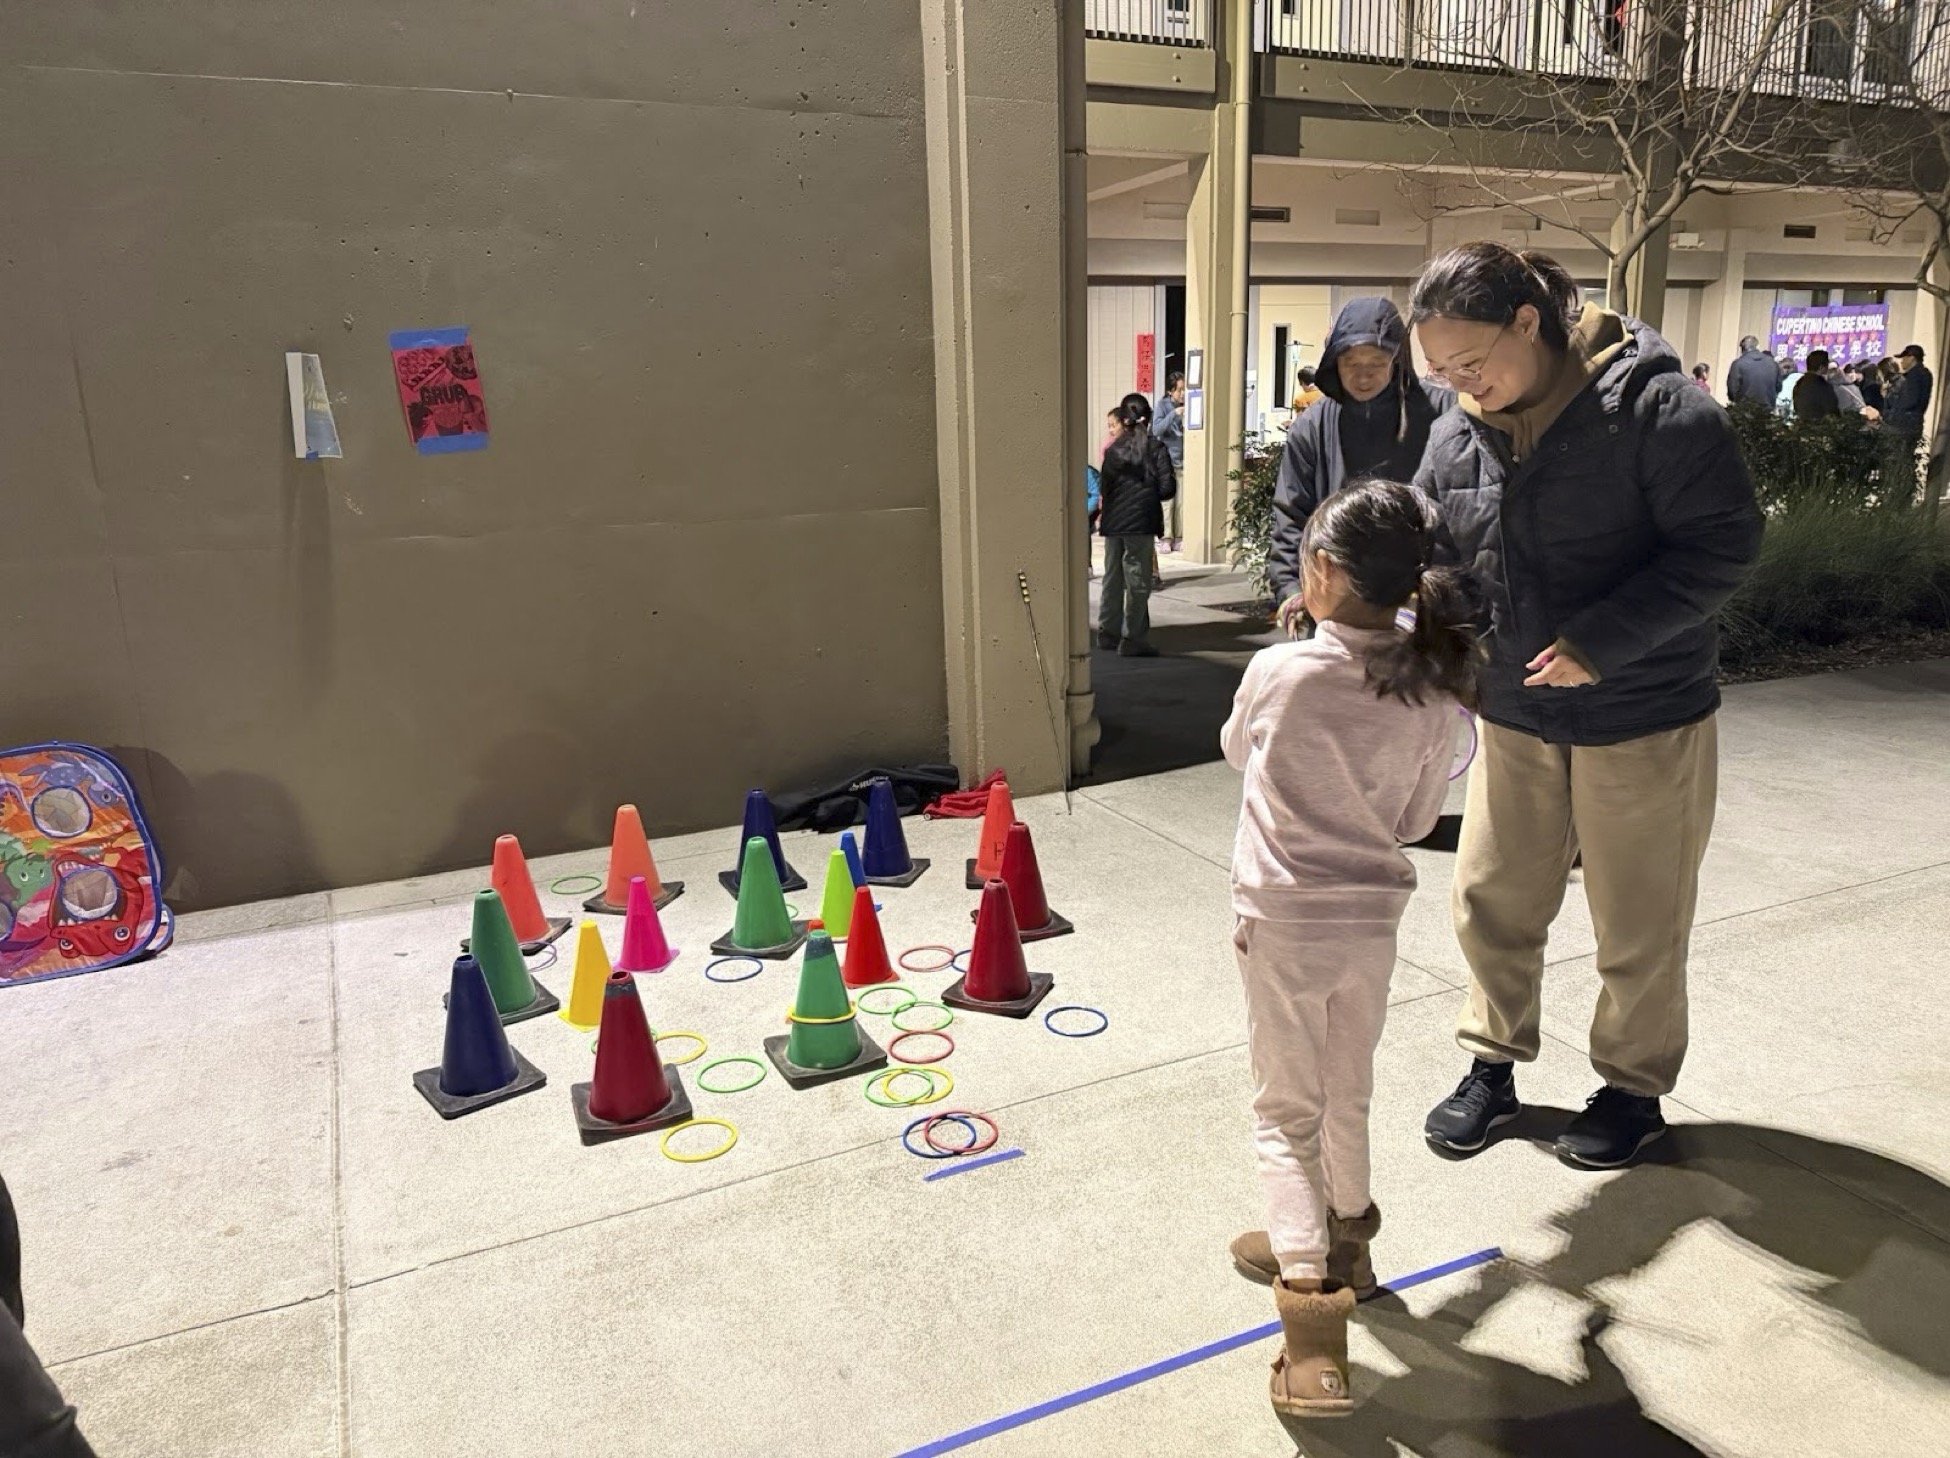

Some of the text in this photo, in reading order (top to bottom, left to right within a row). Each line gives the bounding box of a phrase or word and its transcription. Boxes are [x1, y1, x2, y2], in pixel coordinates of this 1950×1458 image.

[1776, 314, 1884, 335] CUPERTINO CHINESE SCHOOL
